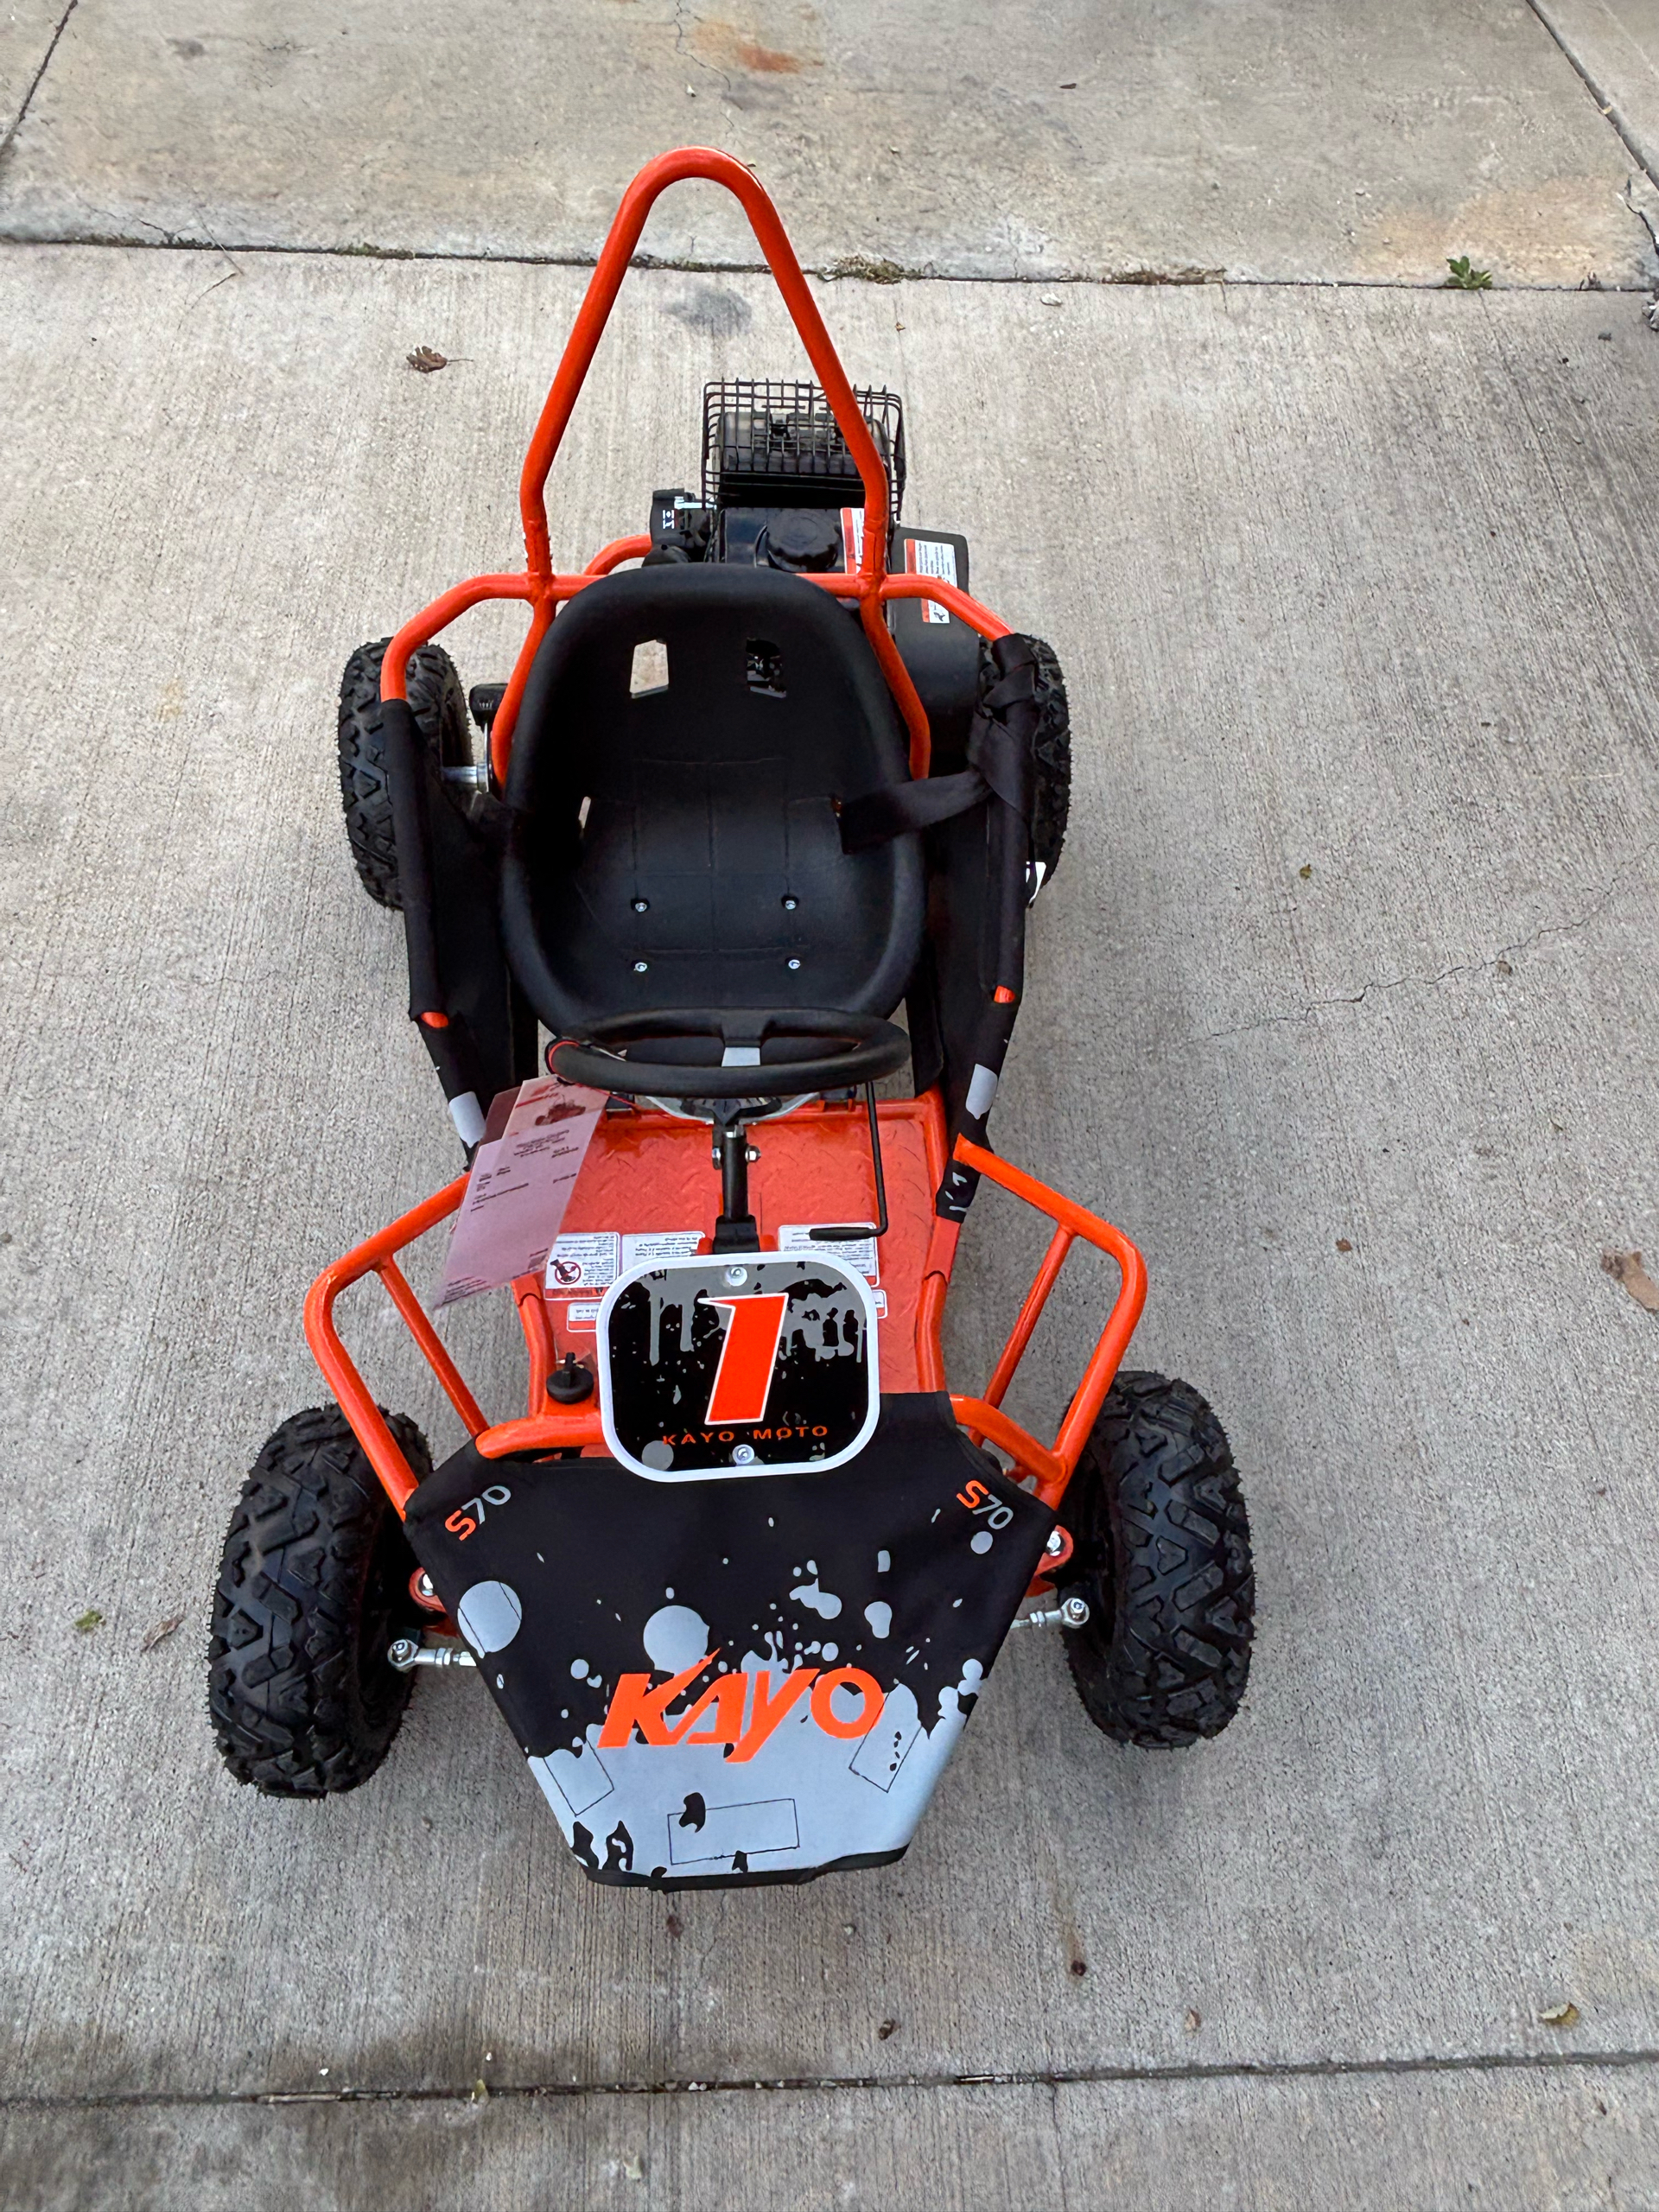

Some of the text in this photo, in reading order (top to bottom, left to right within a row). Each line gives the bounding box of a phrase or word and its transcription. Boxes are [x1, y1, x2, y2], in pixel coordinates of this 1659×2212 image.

[698, 1293, 789, 1426] 1
[662, 1425, 828, 1446] KAYO MOTO
[444, 1485, 512, 1541] S70
[956, 1479, 1014, 1530] S70
[597, 1649, 885, 1764] KAYO
